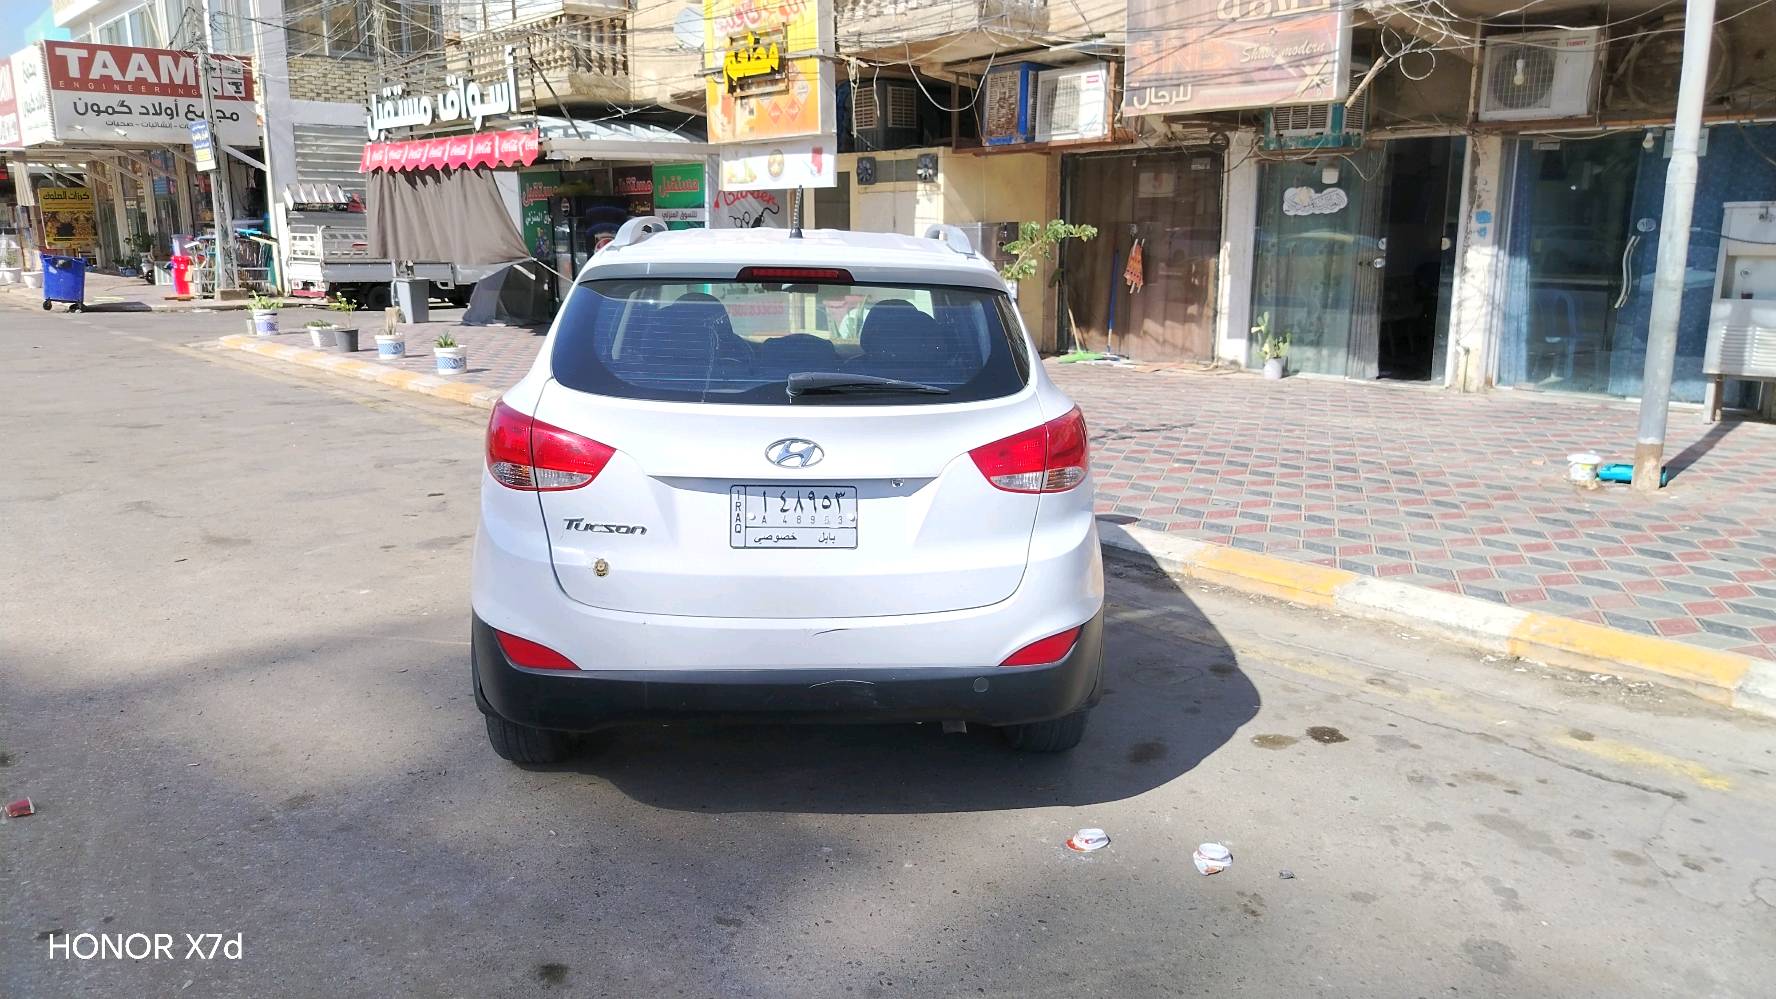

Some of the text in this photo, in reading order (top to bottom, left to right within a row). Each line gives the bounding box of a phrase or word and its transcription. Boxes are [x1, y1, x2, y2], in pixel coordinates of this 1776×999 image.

[59, 80, 198, 96] ENGINEERING
[1133, 83, 1191, 110] للرجال
[138, 99, 180, 120] أولاد
[184, 103, 240, 122] مجع
[367, 84, 432, 141] مستقبل
[659, 176, 699, 198] مستقبل
[563, 518, 648, 535] Tucson
[753, 531, 837, 545] بابل خصوصي
